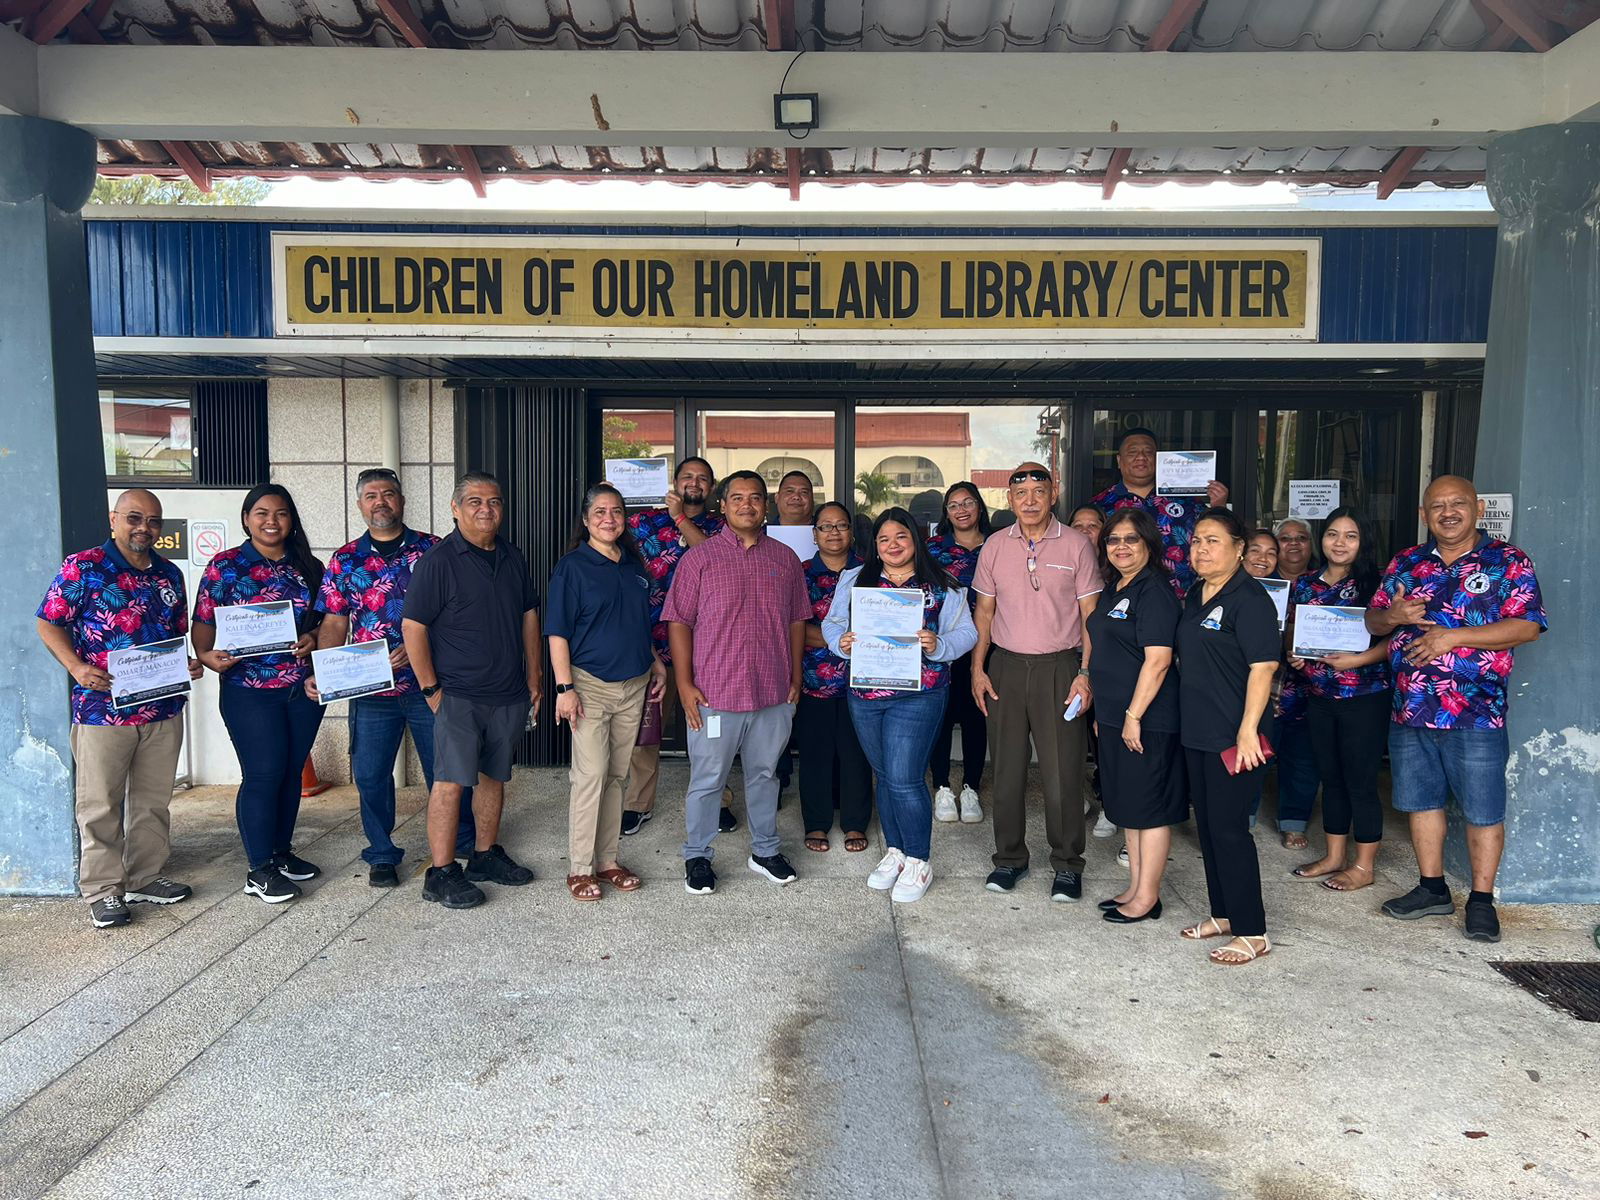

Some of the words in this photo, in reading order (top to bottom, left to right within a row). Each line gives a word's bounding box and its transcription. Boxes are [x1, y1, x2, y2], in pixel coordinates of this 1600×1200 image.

[304, 255, 502, 315] CHILDREN
[524, 257, 575, 317] OF
[592, 258, 675, 317] OUR
[694, 259, 919, 319] HOMELAND
[940, 258, 1291, 319] LIBRARY/CENTER
